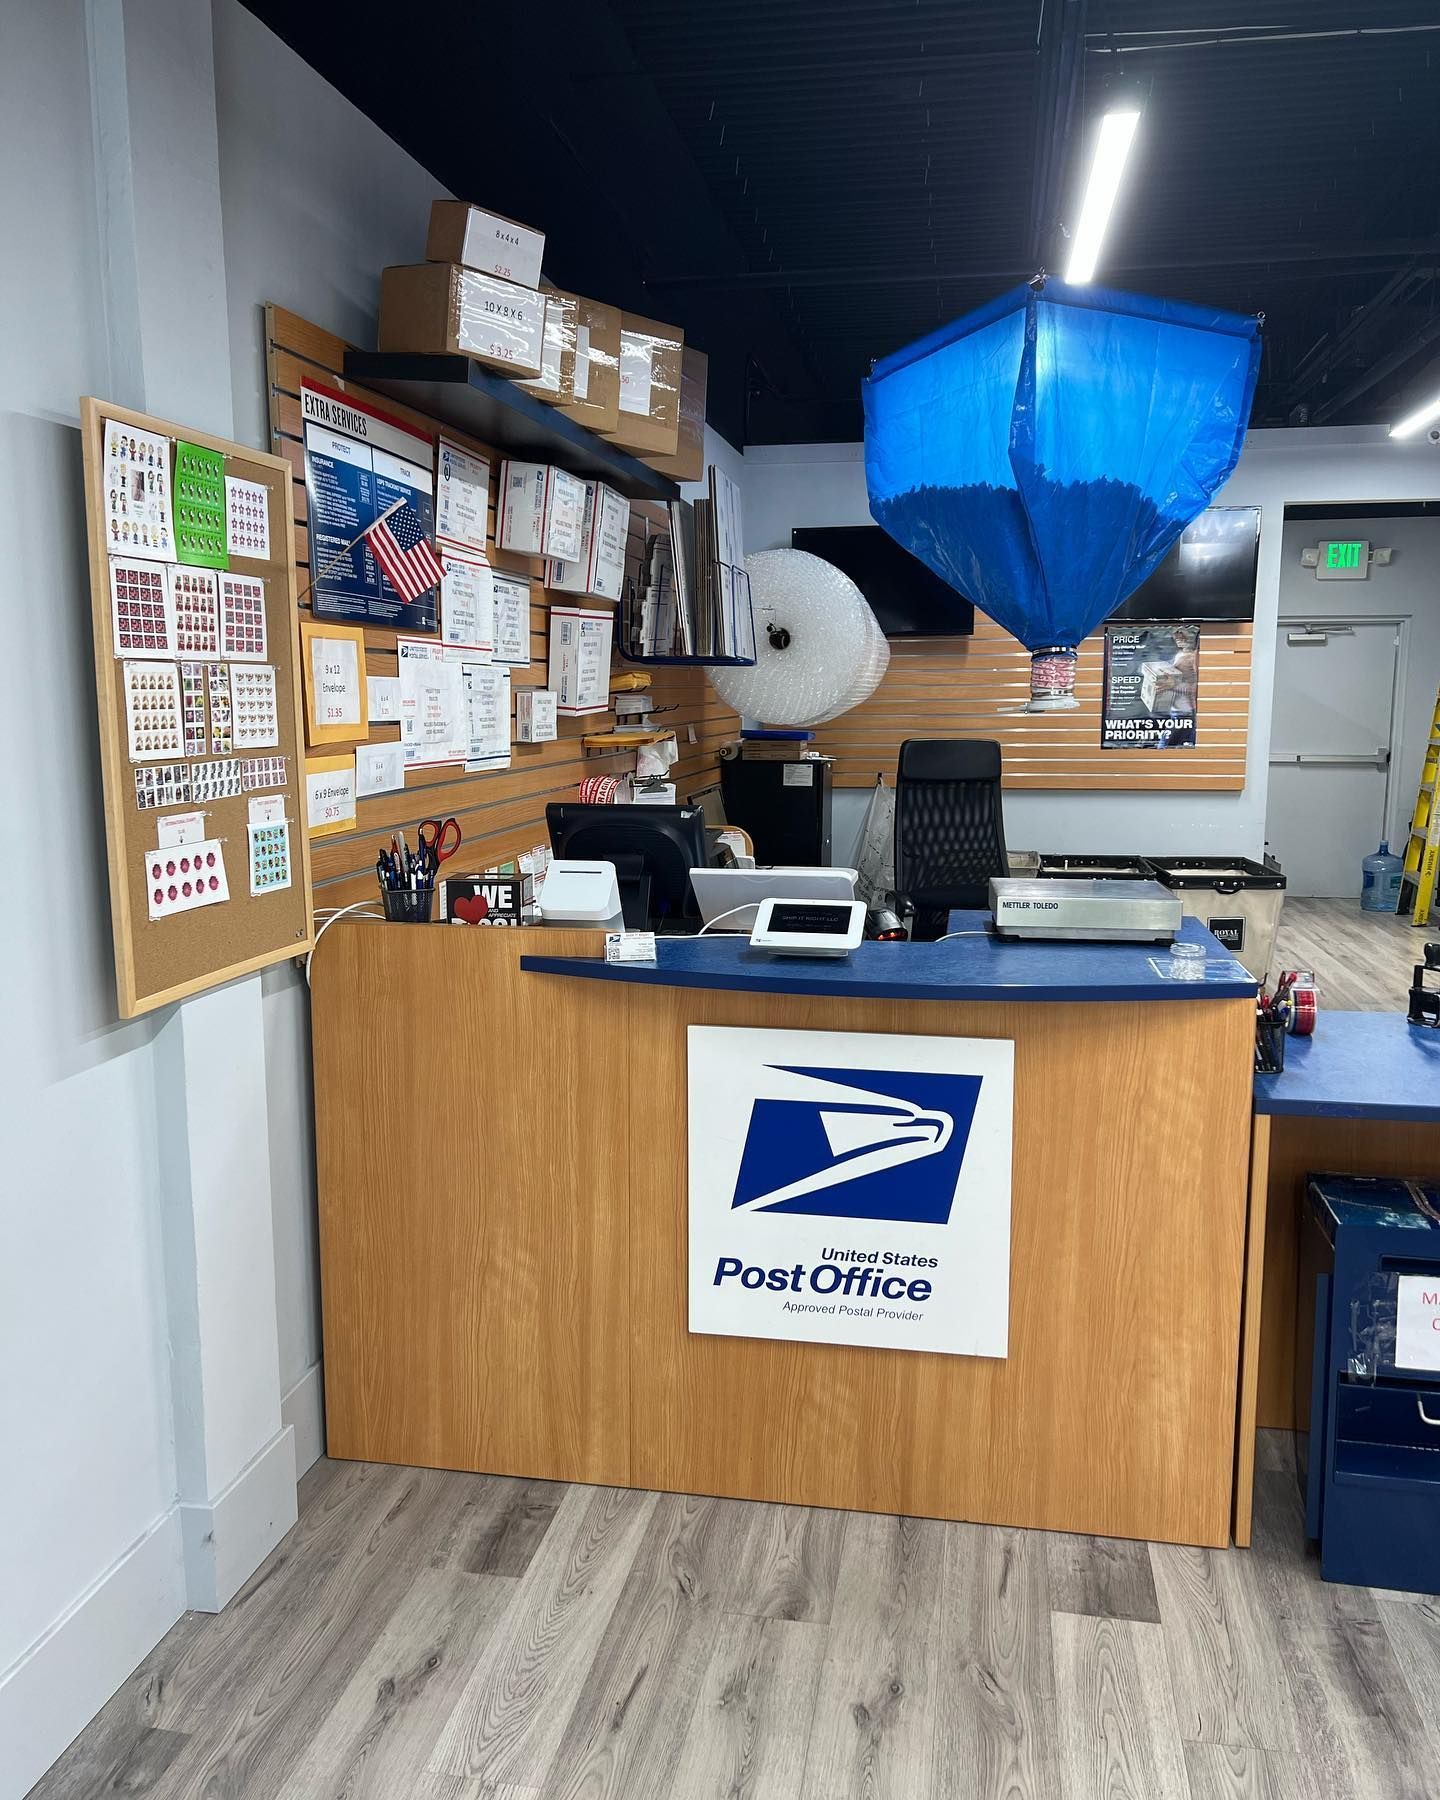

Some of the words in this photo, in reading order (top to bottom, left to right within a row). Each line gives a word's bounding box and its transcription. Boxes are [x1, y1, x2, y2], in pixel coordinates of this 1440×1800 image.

[494, 264, 511, 277] $2.25
[484, 300, 494, 313] 10
[503, 306, 509, 316] 8
[517, 310, 523, 321] 6
[304, 393, 330, 421] EXTRA
[331, 404, 367, 437] SERVICES
[331, 441, 351, 455] PROTECT
[311, 456, 334, 469] INSURANCE
[1326, 543, 1362, 569] EXIT
[1113, 635, 1140, 644] PRICE
[325, 664, 329, 674] 9
[333, 664, 340, 674] 12
[1111, 676, 1141, 684] SPEED
[322, 682, 346, 693] Envelope
[327, 707, 343, 718] $1.35
[1105, 719, 1153, 729] WHAT'S
[1156, 719, 1193, 729] YOUR
[1105, 730, 1171, 740] PRIORITY?
[315, 790, 319, 800] 6
[322, 789, 327, 799] 9
[327, 786, 349, 798] Envelope
[325, 806, 340, 818] $0.75
[473, 884, 513, 908] WE
[1002, 901, 1030, 909] METTLER
[1033, 902, 1059, 910] TOLEDO
[1214, 929, 1239, 938] ROYAL
[821, 1247, 879, 1265] United
[881, 1251, 939, 1269] States
[712, 1257, 806, 1293] Post
[809, 1263, 932, 1302] Office
[1422, 1291, 1440, 1305] M
[782, 1301, 836, 1315] Approved
[838, 1304, 873, 1318] Postal
[876, 1308, 924, 1321] Provider
